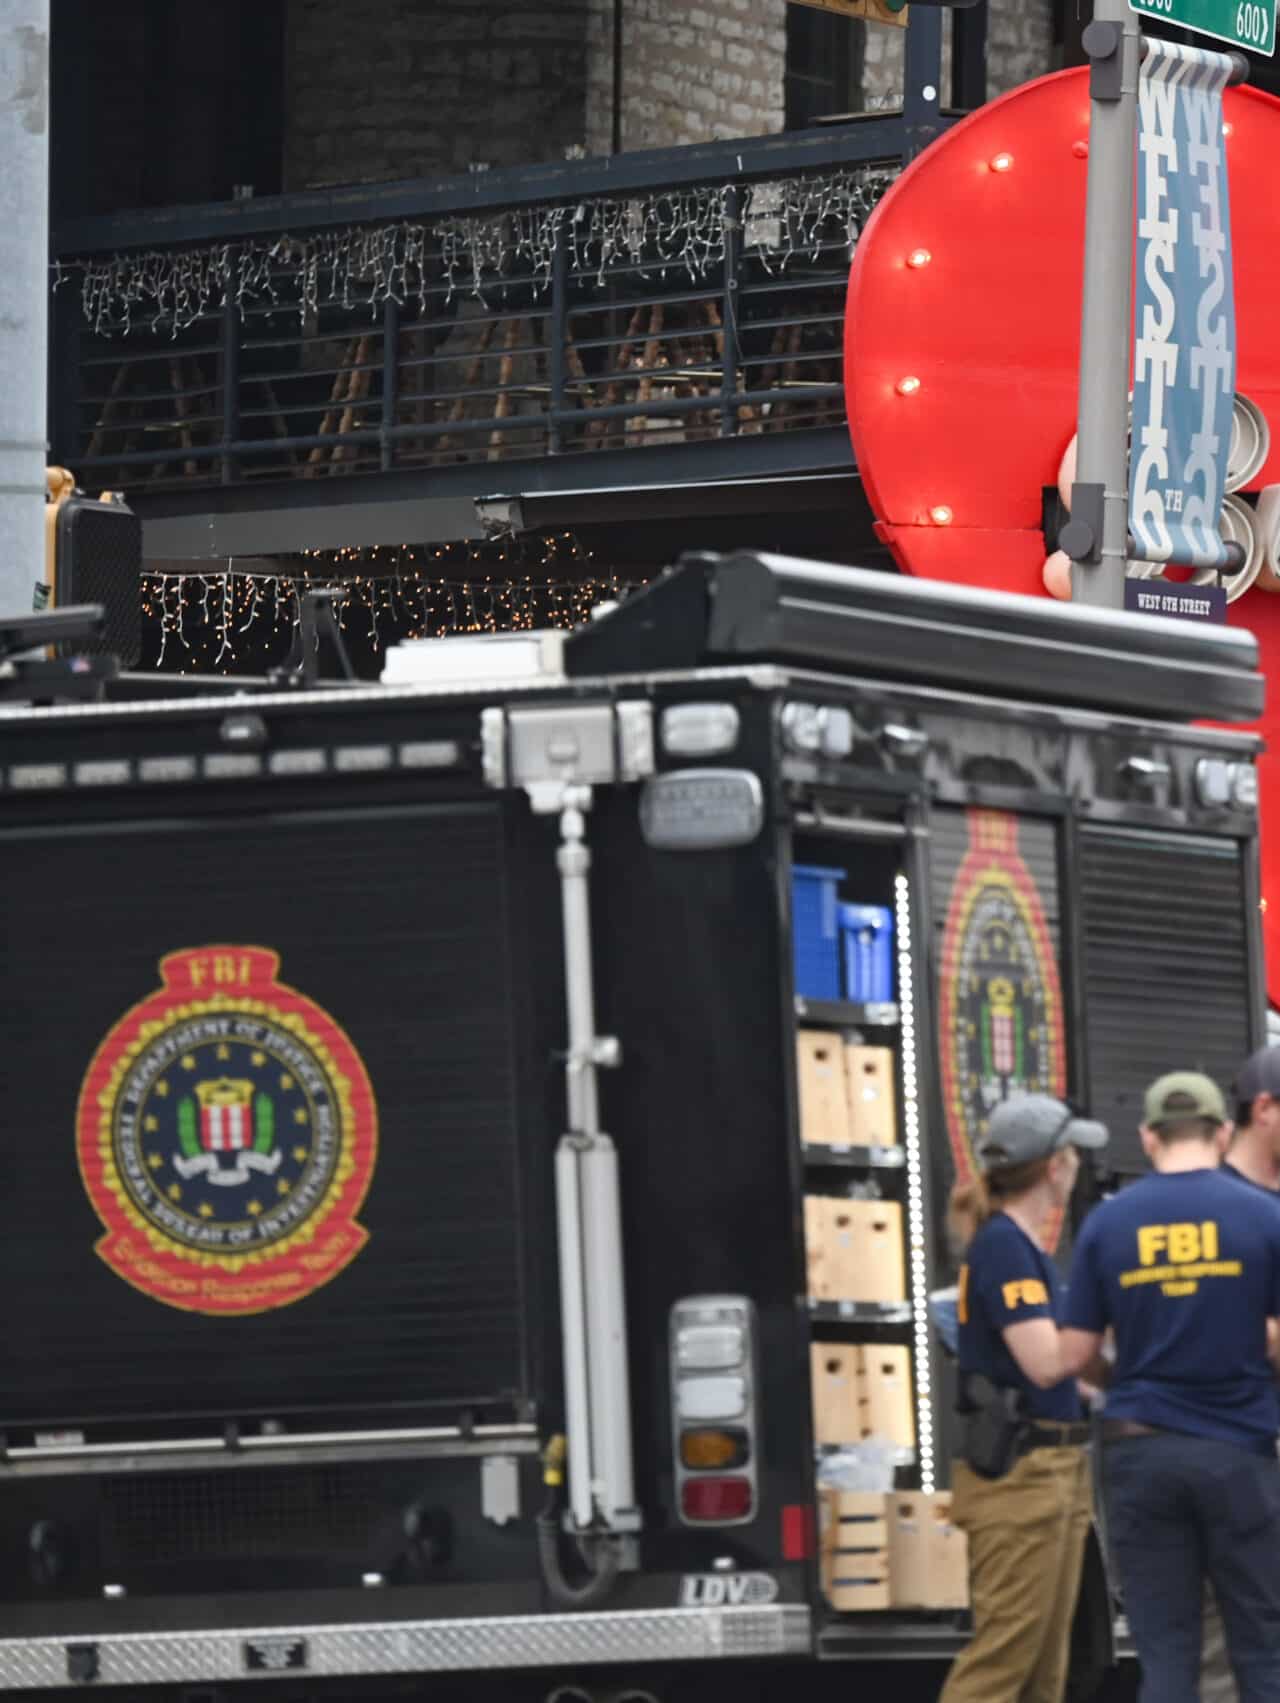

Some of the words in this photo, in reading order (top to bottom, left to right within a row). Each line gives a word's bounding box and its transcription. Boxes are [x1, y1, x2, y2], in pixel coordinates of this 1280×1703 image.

[1236, 2, 1260, 42] 600
[1134, 38, 1179, 449] WEST
[1138, 593, 1160, 610] WEST
[1162, 595, 1178, 613] 6TH
[1180, 598, 1211, 616] STREET
[188, 954, 251, 987] FBI
[1137, 1220, 1218, 1266] FBI
[681, 1574, 750, 1606] LDV
